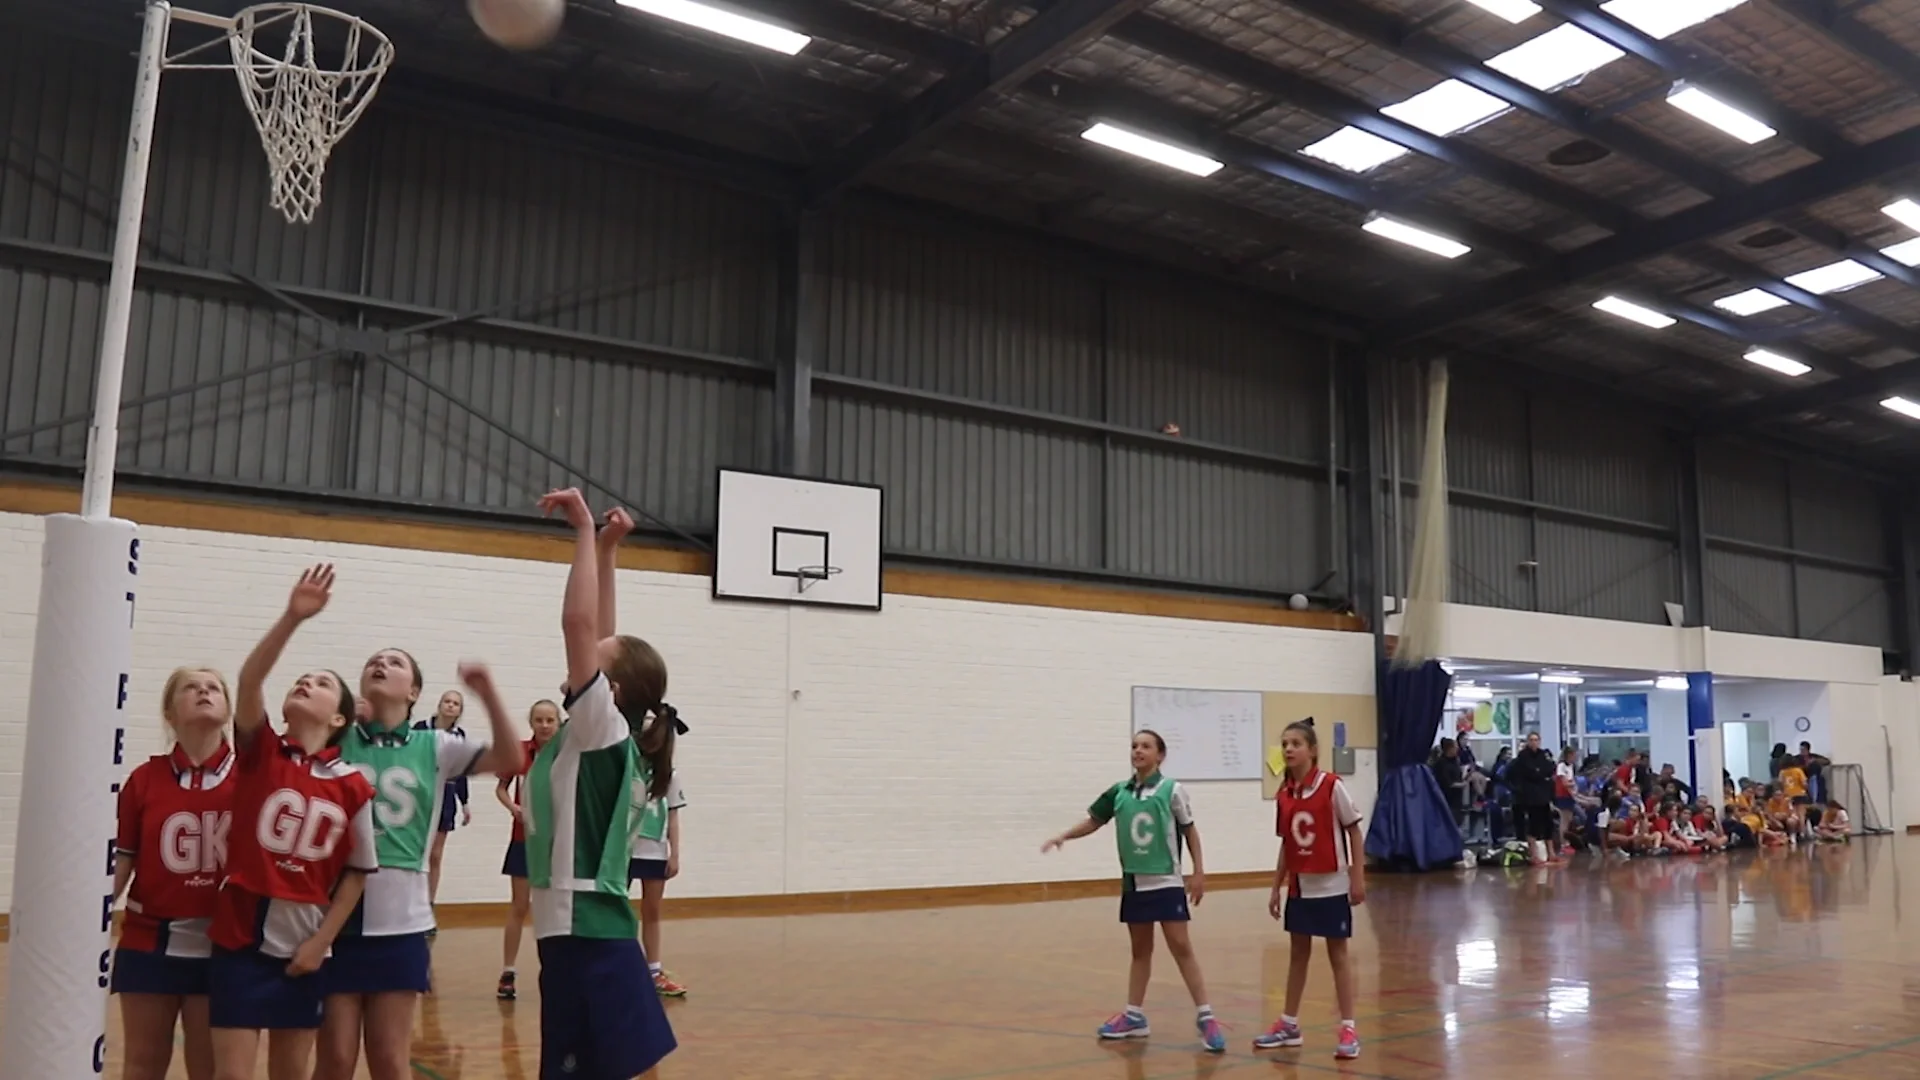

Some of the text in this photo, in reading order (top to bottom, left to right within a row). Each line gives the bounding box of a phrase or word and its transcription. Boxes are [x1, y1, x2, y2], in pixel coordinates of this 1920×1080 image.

[1603, 716, 1644, 726] canteen
[159, 811, 232, 874] GK
[257, 788, 348, 861] GD
[1130, 812, 1154, 846] C
[1291, 811, 1315, 847] C
